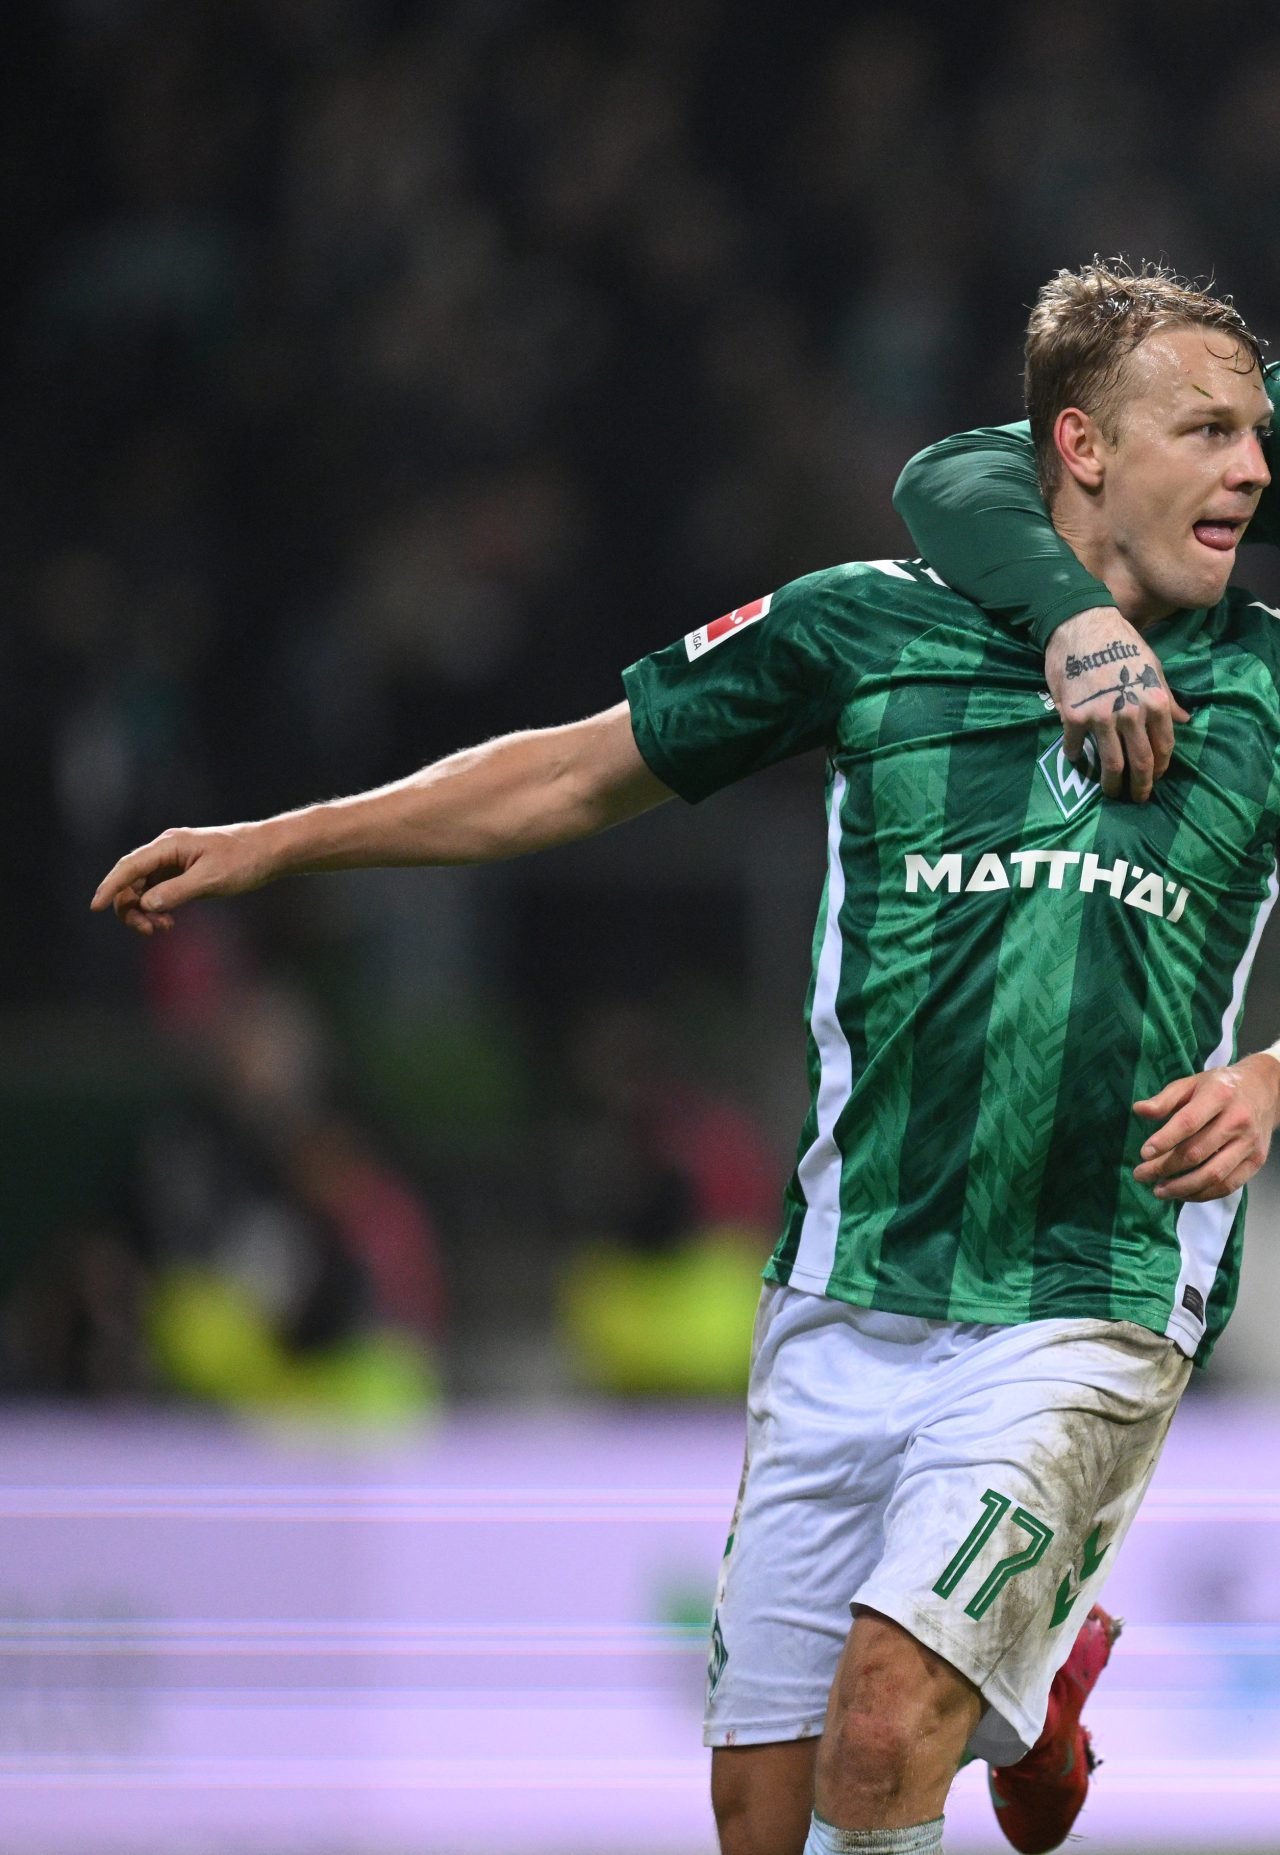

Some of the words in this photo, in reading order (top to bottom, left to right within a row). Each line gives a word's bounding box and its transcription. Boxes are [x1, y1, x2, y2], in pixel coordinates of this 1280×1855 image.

[1065, 640, 1141, 680] Sacrifice
[904, 850, 1191, 923] MATTHÄI
[931, 1488, 1055, 1622] 17
